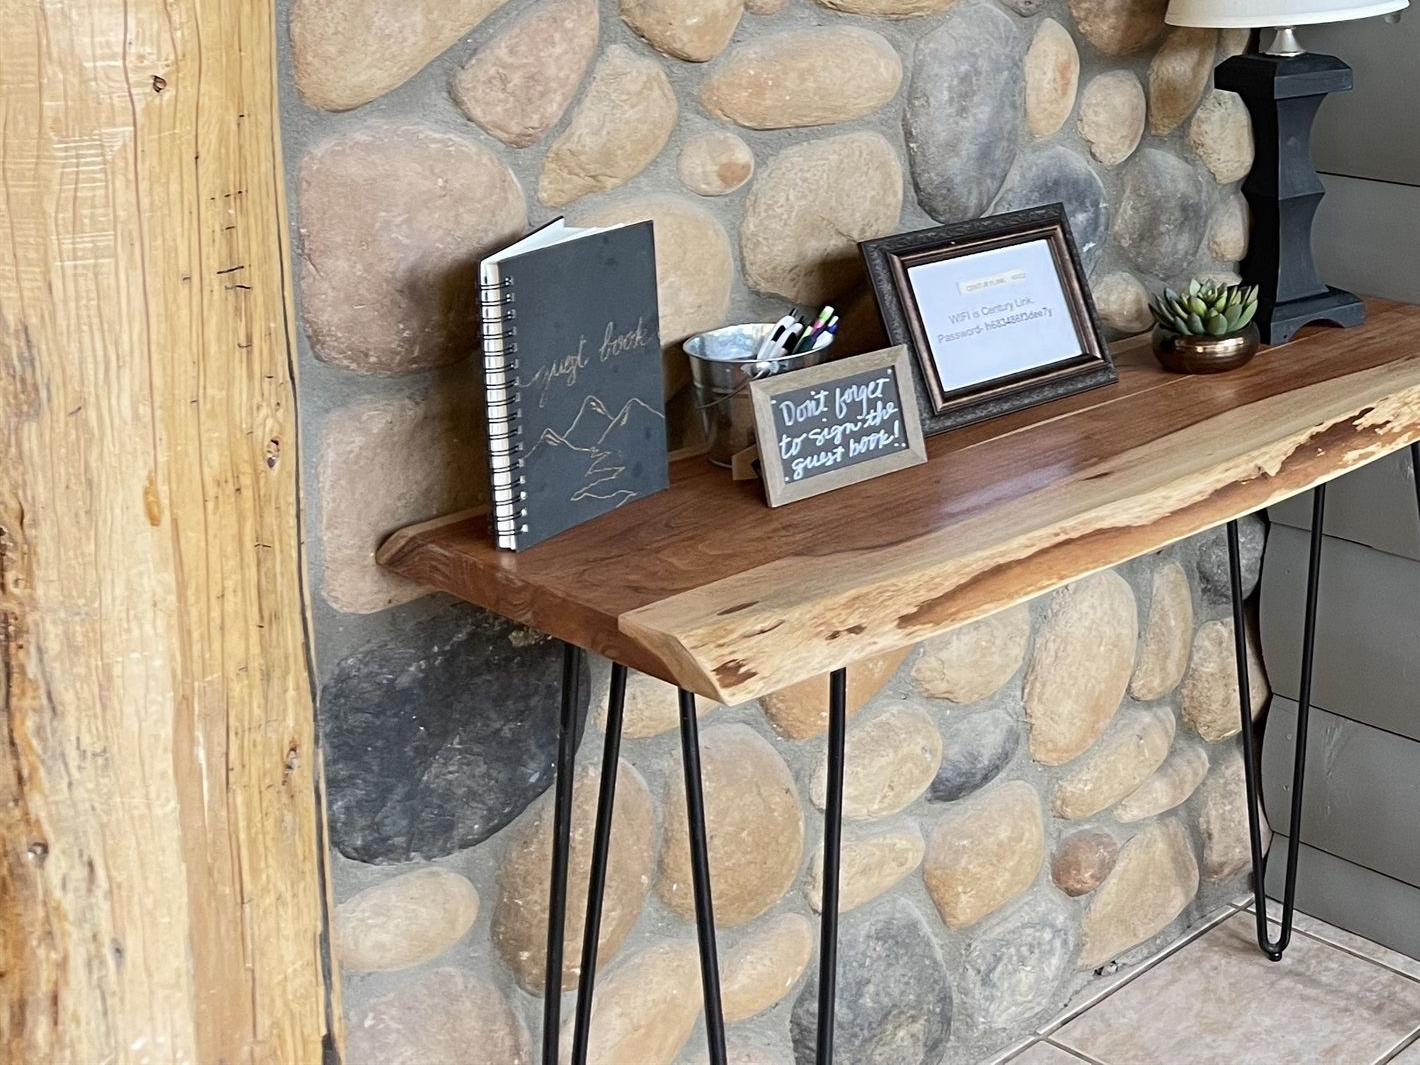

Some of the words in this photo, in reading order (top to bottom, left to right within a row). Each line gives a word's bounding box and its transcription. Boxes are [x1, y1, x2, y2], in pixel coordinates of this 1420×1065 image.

[981, 302, 1013, 315] Century
[598, 316, 653, 363] book
[835, 377, 891, 419] forget
[778, 432, 808, 460] to
[807, 418, 862, 446] sign
[862, 400, 899, 429] the
[791, 446, 845, 481] guest
[849, 419, 899, 458] book!
